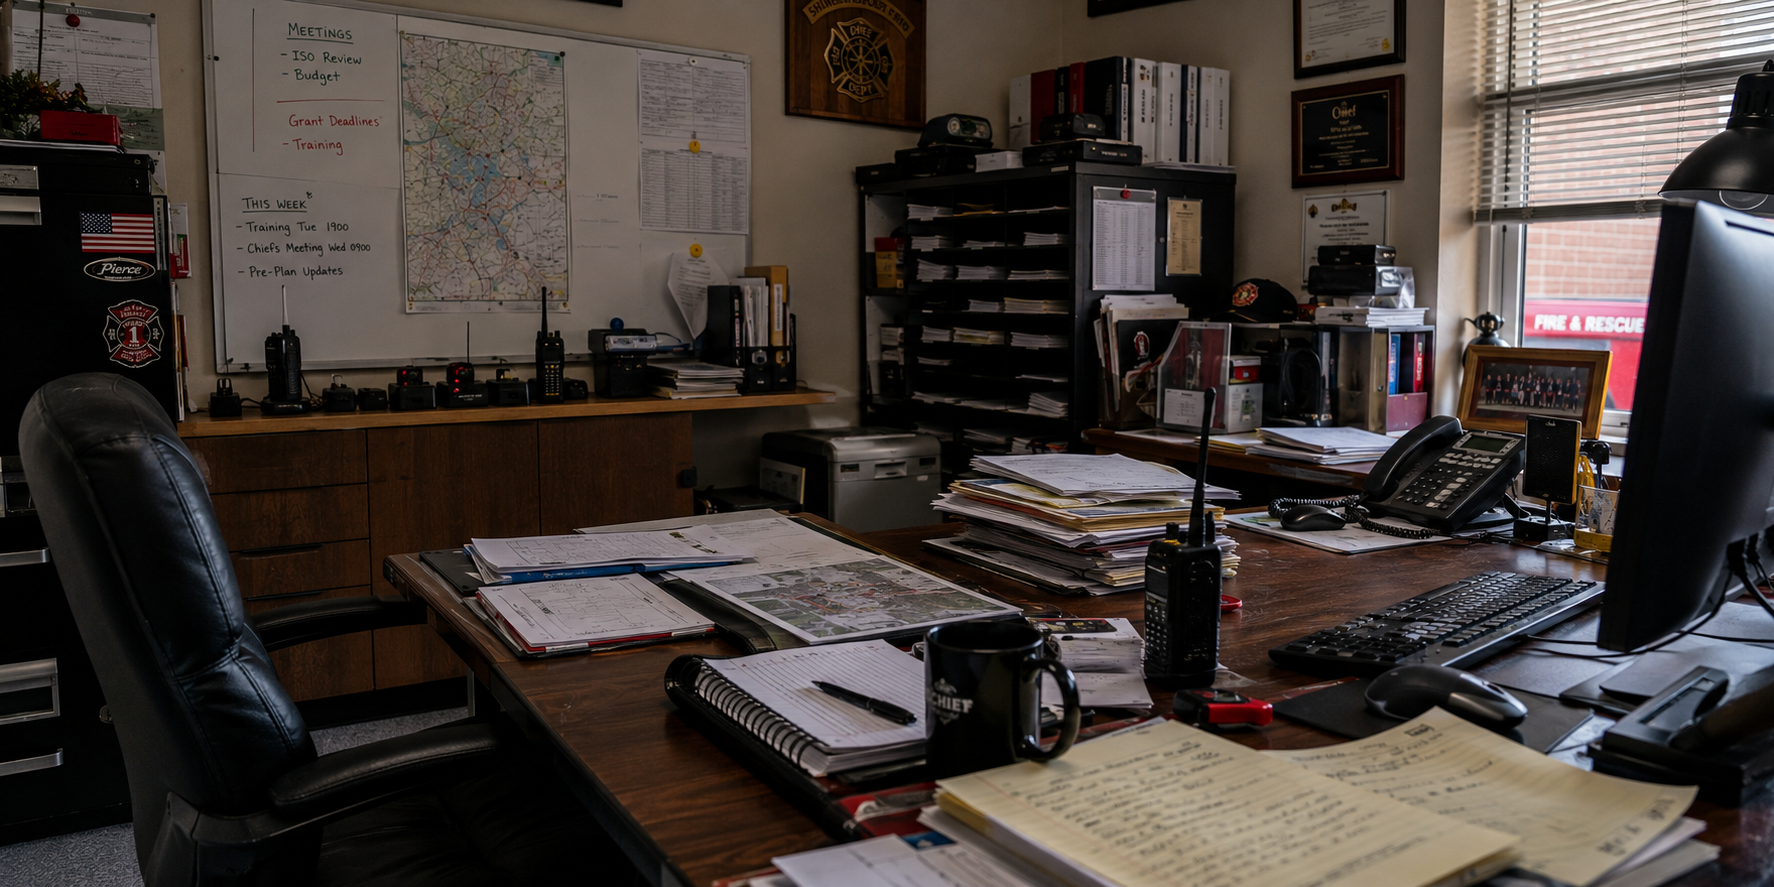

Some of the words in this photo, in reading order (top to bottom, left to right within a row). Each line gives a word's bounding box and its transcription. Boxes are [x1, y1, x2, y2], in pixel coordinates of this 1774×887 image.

[292, 50, 315, 62] ISO
[323, 52, 362, 65] Review
[294, 69, 341, 86] Budget
[288, 114, 324, 127] Grant
[328, 115, 380, 127] Deadlines
[292, 138, 344, 156] Training
[242, 197, 270, 210] THIS
[276, 199, 307, 210] WEEK
[246, 221, 291, 237] Training
[296, 221, 317, 232] Tue
[326, 222, 349, 232] 1900
[247, 242, 281, 254] Chiefs
[286, 243, 324, 257] Meeting
[328, 242, 346, 252] Wed
[350, 243, 371, 252] 0900
[97, 263, 142, 276] Pierce
[249, 265, 297, 278] Pre-Plan
[302, 265, 344, 281] Updates
[1534, 314, 1568, 331] FIRE
[1569, 315, 1582, 332] &
[1584, 316, 1646, 333] RESCUE
[129, 326, 139, 343] 1
